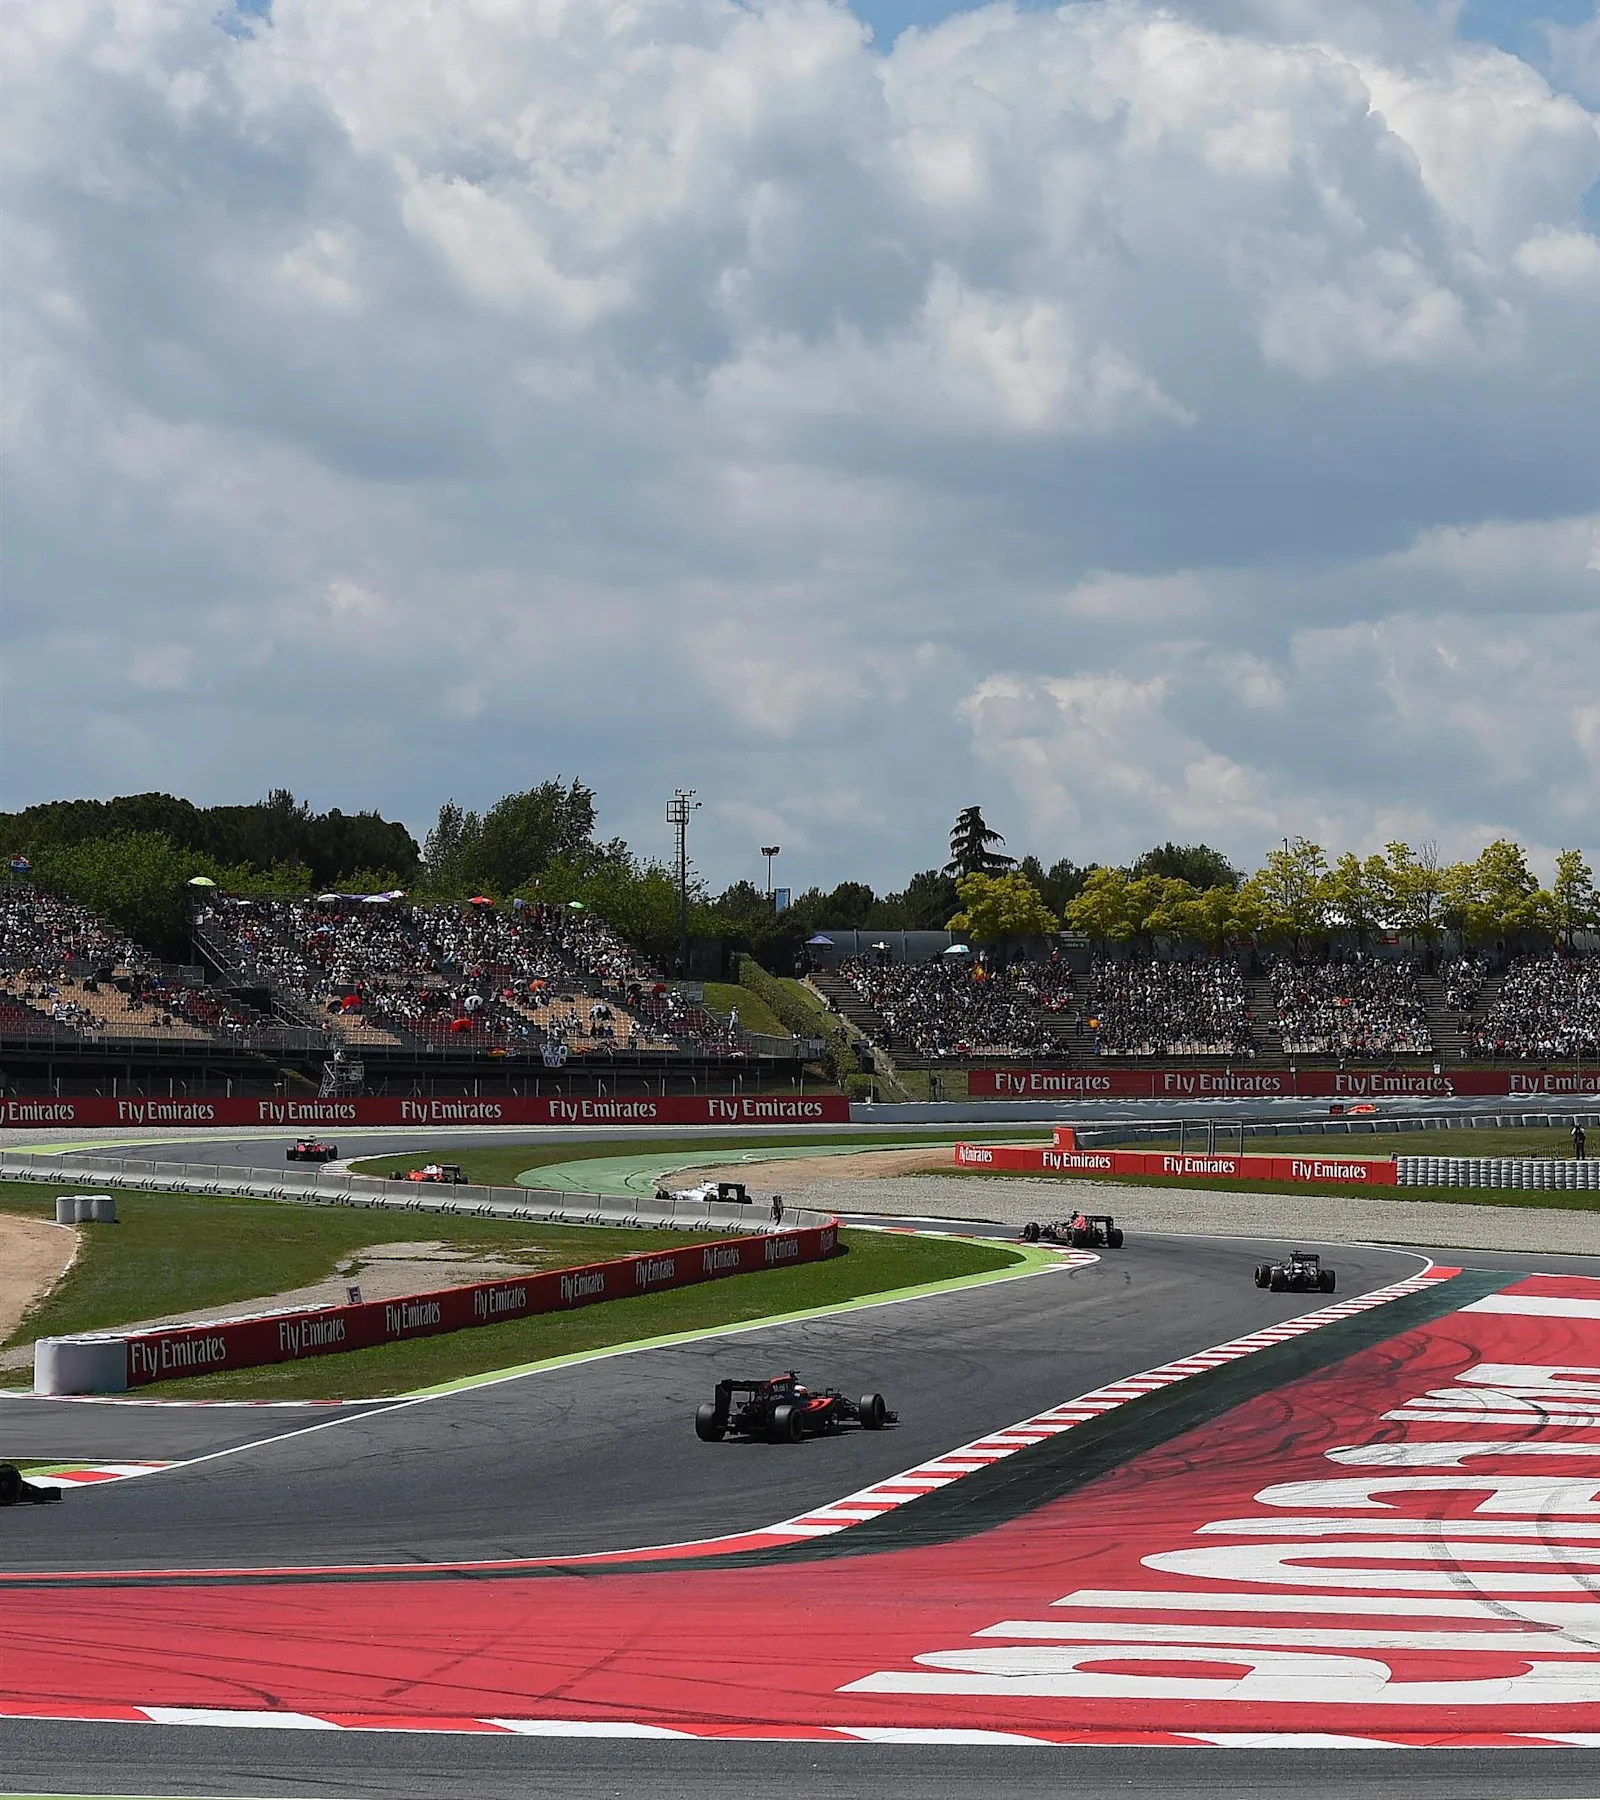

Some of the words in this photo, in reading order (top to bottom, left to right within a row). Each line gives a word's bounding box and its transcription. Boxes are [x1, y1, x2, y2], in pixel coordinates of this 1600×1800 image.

[995, 1074, 1026, 1093] Fly
[1030, 1072, 1111, 1091] Emirates
[1164, 1074, 1196, 1093] Fly
[1199, 1072, 1281, 1091] Emirates
[1336, 1074, 1367, 1094] Fly
[1371, 1074, 1453, 1092] Emirates
[1511, 1074, 1539, 1094] Fly
[9, 1100, 75, 1121] Emirates
[119, 1101, 145, 1124] Fly
[148, 1100, 214, 1121] Emirates
[259, 1101, 285, 1124] Fly
[288, 1100, 356, 1121] Emirates
[401, 1100, 428, 1124] Fly
[432, 1100, 502, 1120] Emirates
[550, 1100, 578, 1121] Fly
[582, 1099, 657, 1118] Emirates
[709, 1099, 739, 1120] Fly
[742, 1098, 823, 1117] Emirates
[966, 1149, 993, 1163] Emirates
[1042, 1152, 1062, 1169] Fly
[1063, 1153, 1111, 1169] Emirates
[1163, 1157, 1182, 1175] Fly
[1184, 1157, 1235, 1174] Emirates
[1291, 1160, 1311, 1179] Fly
[1314, 1163, 1366, 1180] Emirates
[703, 1248, 713, 1275] Fly
[714, 1246, 740, 1269] Emirates
[765, 1238, 775, 1264] Fly
[775, 1236, 798, 1258] Emirates
[636, 1260, 648, 1288] Fly
[649, 1257, 675, 1282] Emirates
[348, 1288, 359, 1302] F
[560, 1274, 574, 1304] Fly
[575, 1271, 604, 1296] Emirates
[474, 1289, 488, 1319] Fly
[489, 1285, 526, 1314] Emirates
[385, 1304, 401, 1337] Fly
[403, 1300, 441, 1327] Emirates
[279, 1322, 300, 1356] Fly
[302, 1316, 346, 1347] Emirates
[131, 1343, 158, 1376] Fly
[162, 1337, 226, 1368] Emirates
